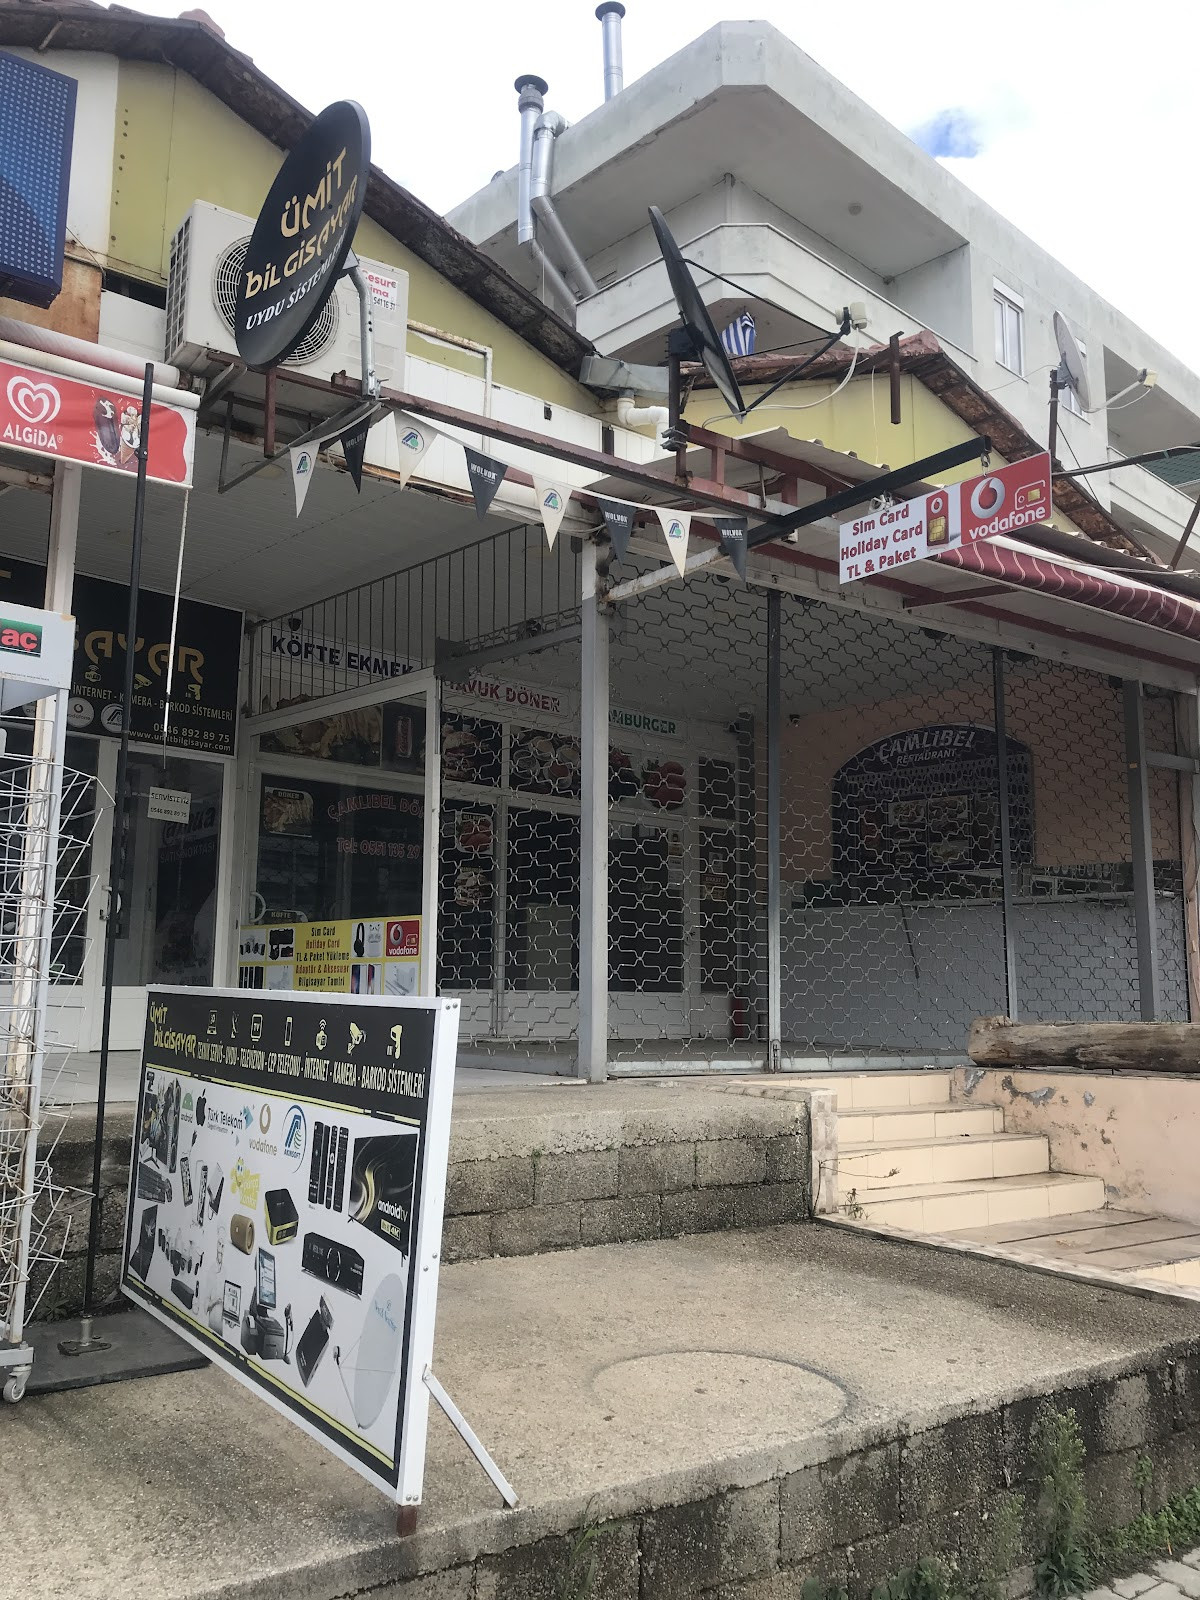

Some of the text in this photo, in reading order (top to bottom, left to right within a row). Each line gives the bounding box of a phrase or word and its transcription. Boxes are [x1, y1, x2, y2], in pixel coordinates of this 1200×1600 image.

[280, 146, 347, 238] ÜMİT
[245, 298, 286, 330] UYDU
[852, 504, 910, 536] Sim Card
[968, 506, 1046, 540] vodafone
[841, 521, 923, 561] Holiday Card
[846, 546, 917, 579] TL & Paket
[0, 621, 38, 652] aç
[74, 630, 205, 684] AYAR
[272, 635, 341, 666] KÖFTE
[72, 682, 113, 699] İNTERNET
[119, 692, 152, 707] KMERA
[159, 700, 190, 714] BRKOD
[191, 704, 233, 721] SİSTEMLERİ
[505, 686, 560, 712] DÖNER
[608, 709, 676, 734] MBURGER
[181, 727, 200, 739] 892
[202, 731, 215, 741] 89
[218, 733, 230, 743] 75
[336, 837, 421, 859] Tel: 0551 135 29
[305, 938, 340, 950] Holiday Card
[311, 926, 336, 937] Sim Card
[309, 951, 325, 962] Paket
[326, 950, 350, 961] Yükleme
[388, 946, 418, 956] vodafone
[323, 964, 350, 974] Aksesuar
[298, 976, 345, 988] Bilgisayar Tamiri
[150, 1001, 168, 1025] ÜMİT
[267, 1052, 277, 1072] CEP
[304, 1051, 330, 1081] İNTERNET
[332, 1061, 357, 1087] KAMERA
[361, 1065, 387, 1091] BARKOD
[387, 1063, 426, 1099] SİSTEMLERİ
[207, 1107, 219, 1123] Türk
[220, 1110, 243, 1130] Telekom
[248, 1137, 278, 1156] vodafone
